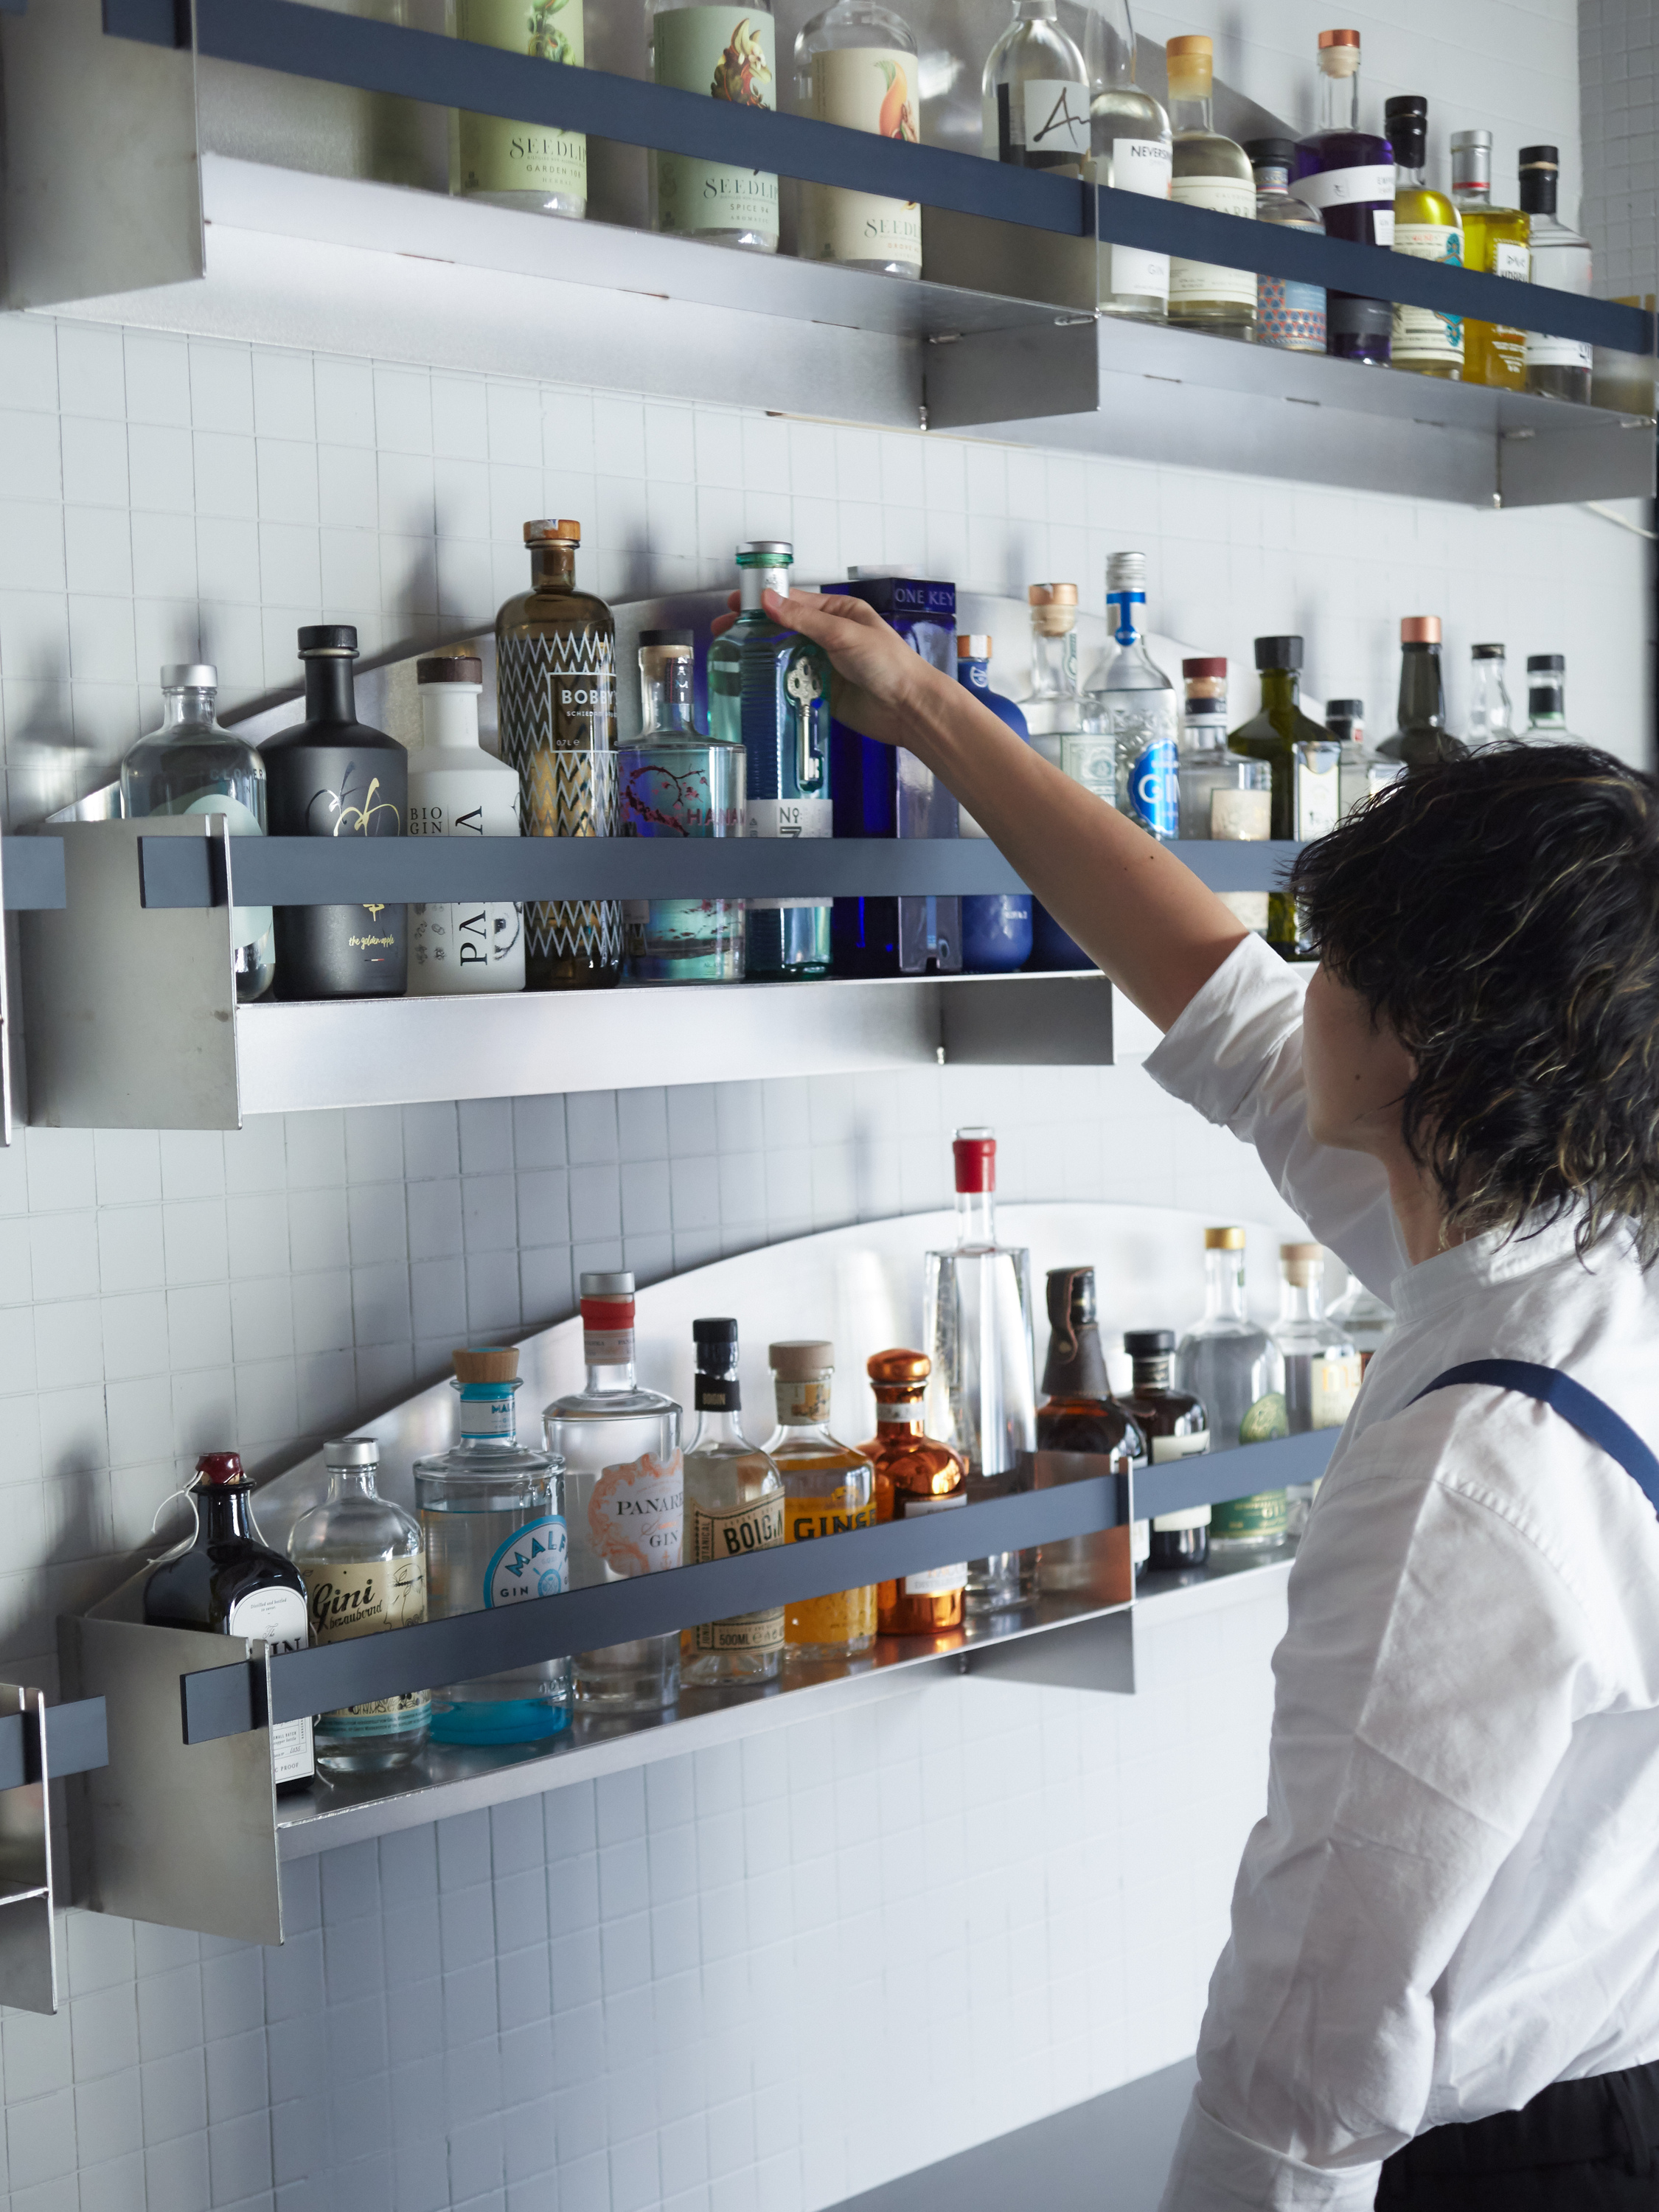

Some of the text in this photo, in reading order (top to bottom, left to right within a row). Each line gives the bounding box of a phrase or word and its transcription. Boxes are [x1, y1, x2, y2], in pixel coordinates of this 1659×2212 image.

[526, 165, 567, 175] GARDEN
[730, 204, 757, 212] SPICE
[895, 588, 955, 606] ONE KEY
[209, 768, 263, 781] CLOVER
[410, 807, 442, 820] BIO
[410, 821, 442, 835] GIN
[349, 934, 394, 950] the golden apple
[650, 1530, 678, 1548] GIN
[701, 1522, 710, 1562] OTANICAL
[500, 1586, 529, 1597] GIN
[313, 1579, 375, 1634] Gini
[329, 1599, 383, 1630] bezaubernd
[720, 1634, 750, 1646] 500ML
[280, 1762, 299, 1772] PROOF
